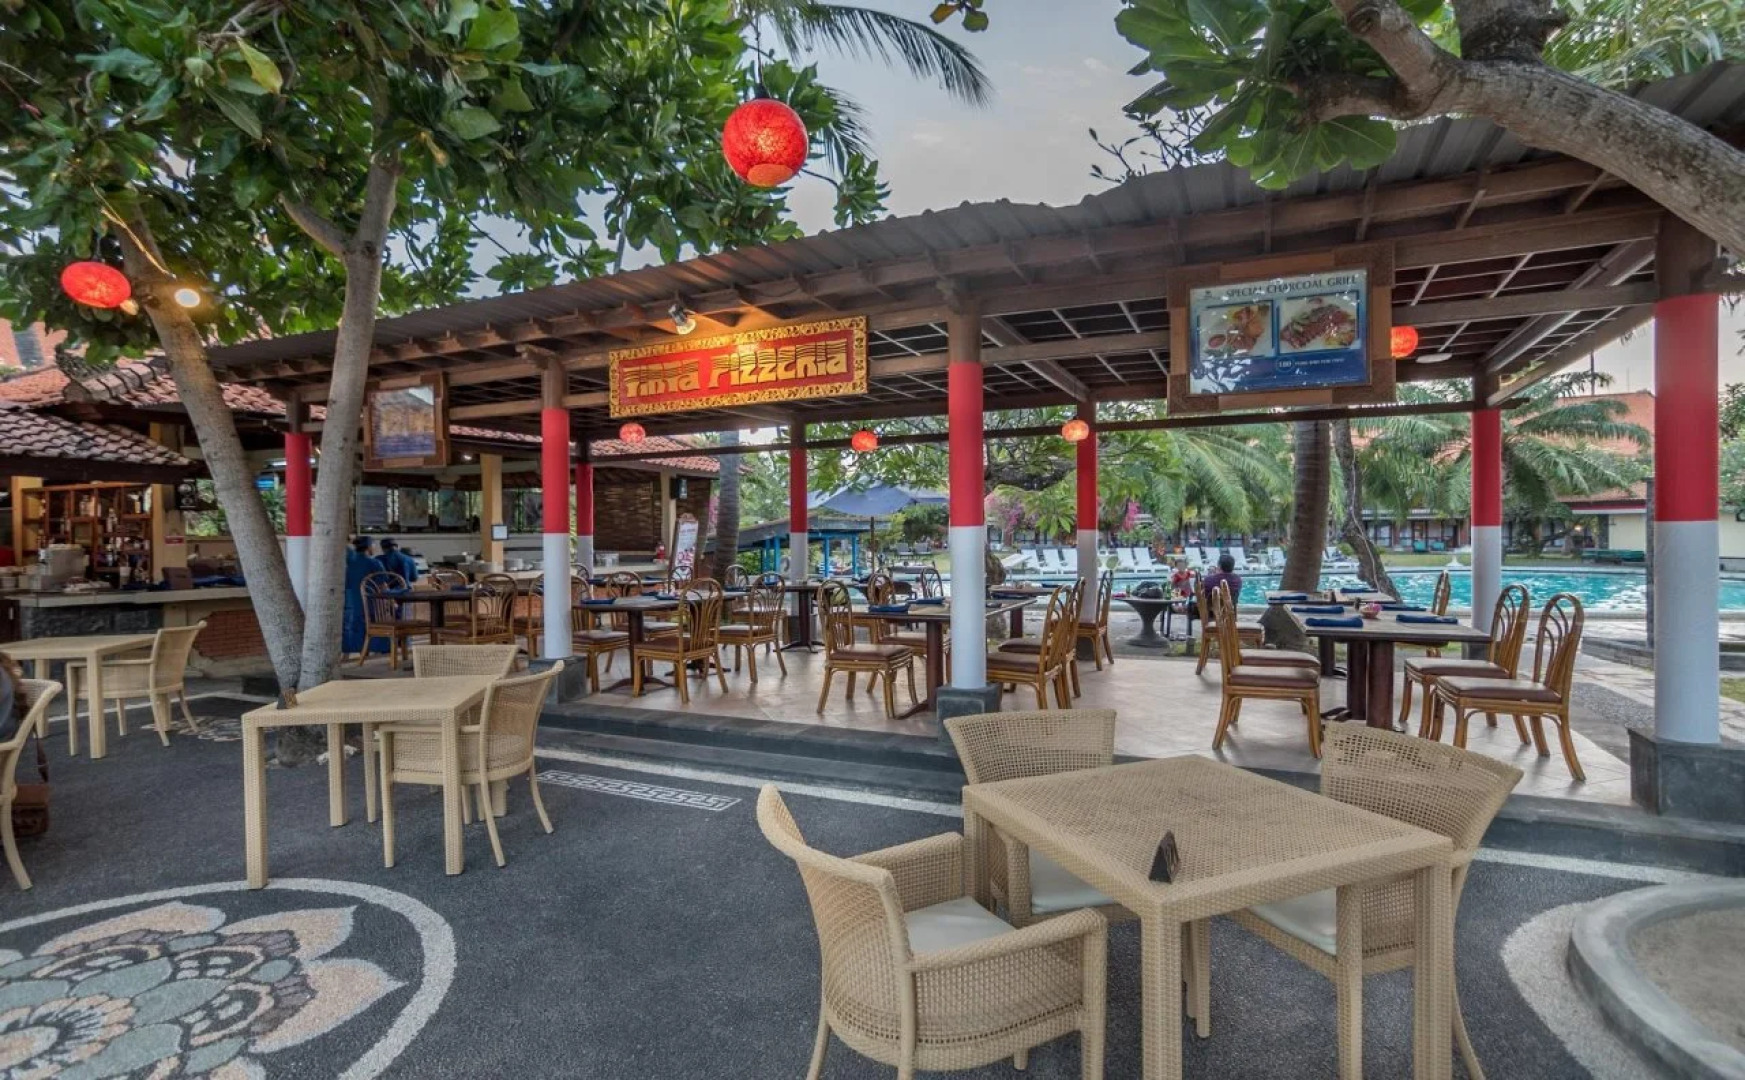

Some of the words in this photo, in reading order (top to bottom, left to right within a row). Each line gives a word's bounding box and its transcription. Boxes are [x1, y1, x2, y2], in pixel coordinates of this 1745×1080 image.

[1226, 285, 1264, 297] SPECIAL
[1266, 278, 1324, 294] CHARCOAL
[1327, 275, 1357, 287] GRILL
